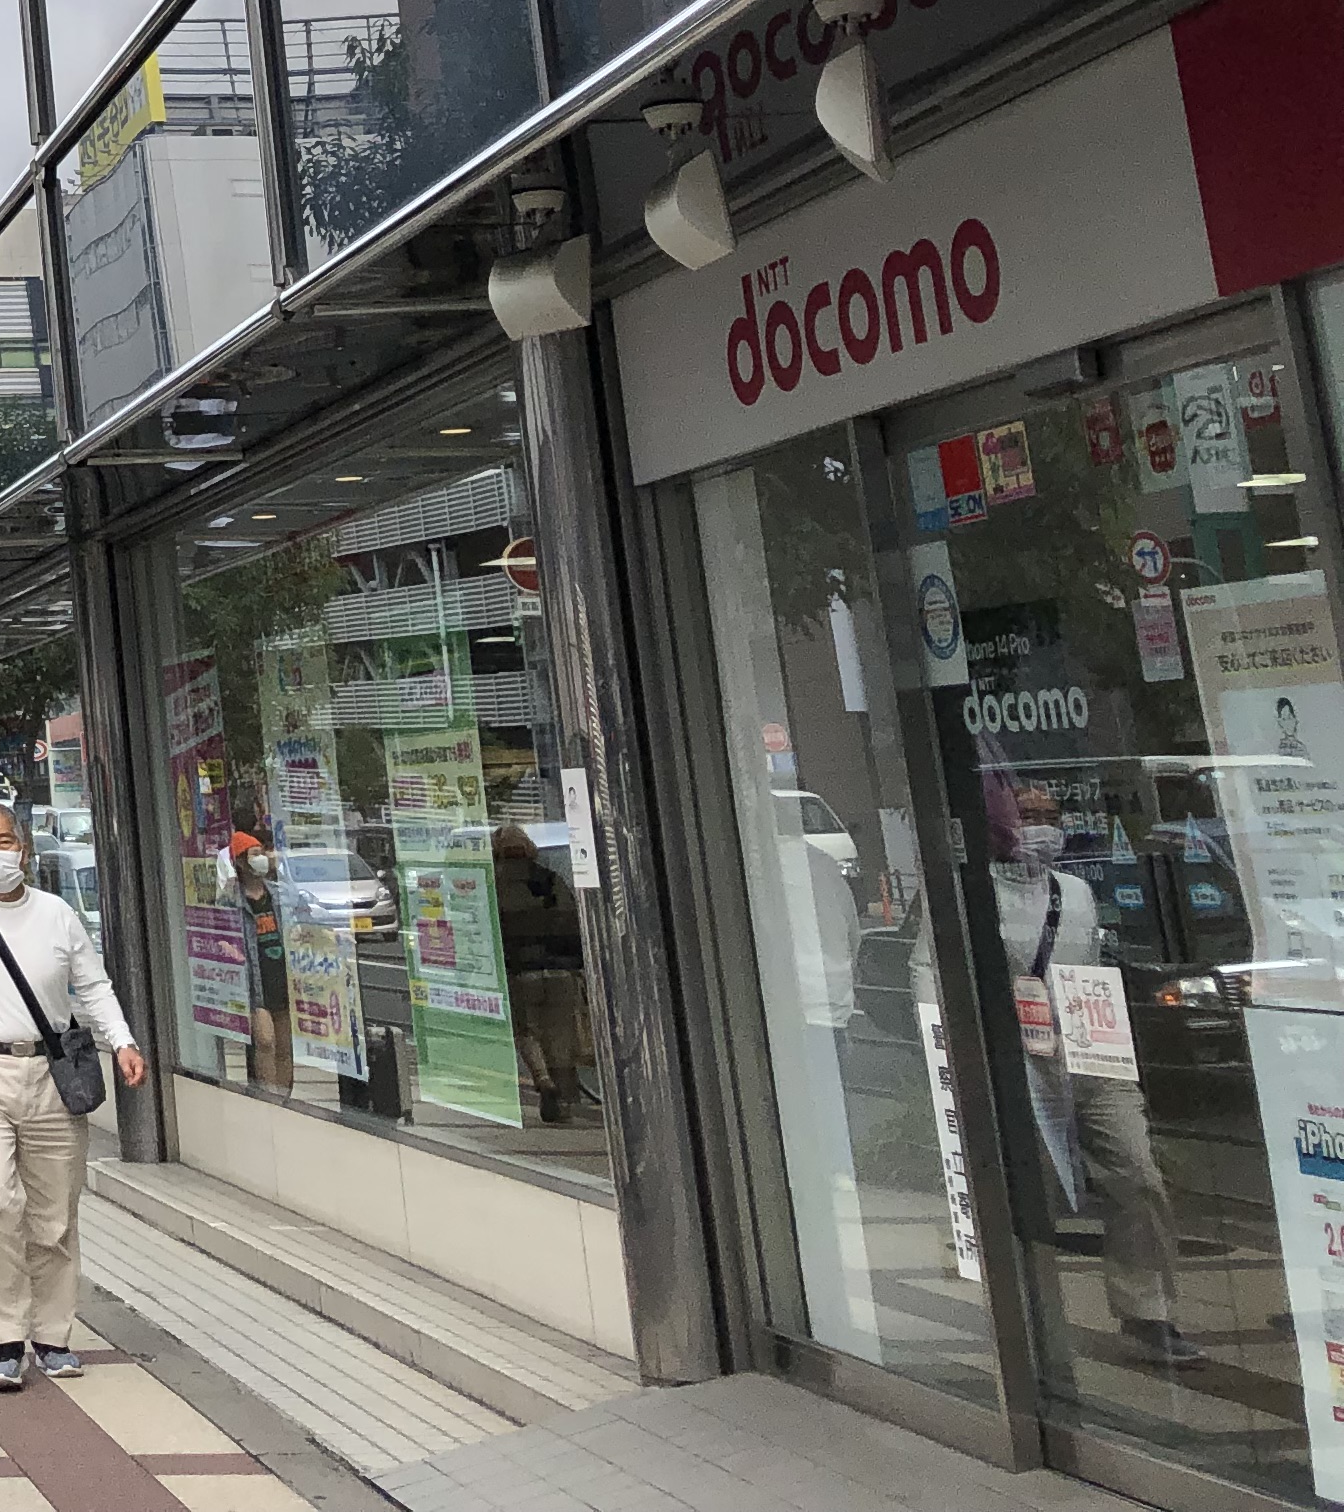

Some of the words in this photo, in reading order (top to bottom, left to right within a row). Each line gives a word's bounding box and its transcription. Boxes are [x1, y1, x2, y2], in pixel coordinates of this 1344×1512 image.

[755, 255, 791, 297] NTT
[726, 218, 1002, 408] docomo
[962, 679, 1089, 735] docomo
[1081, 979, 1112, 998] こども
